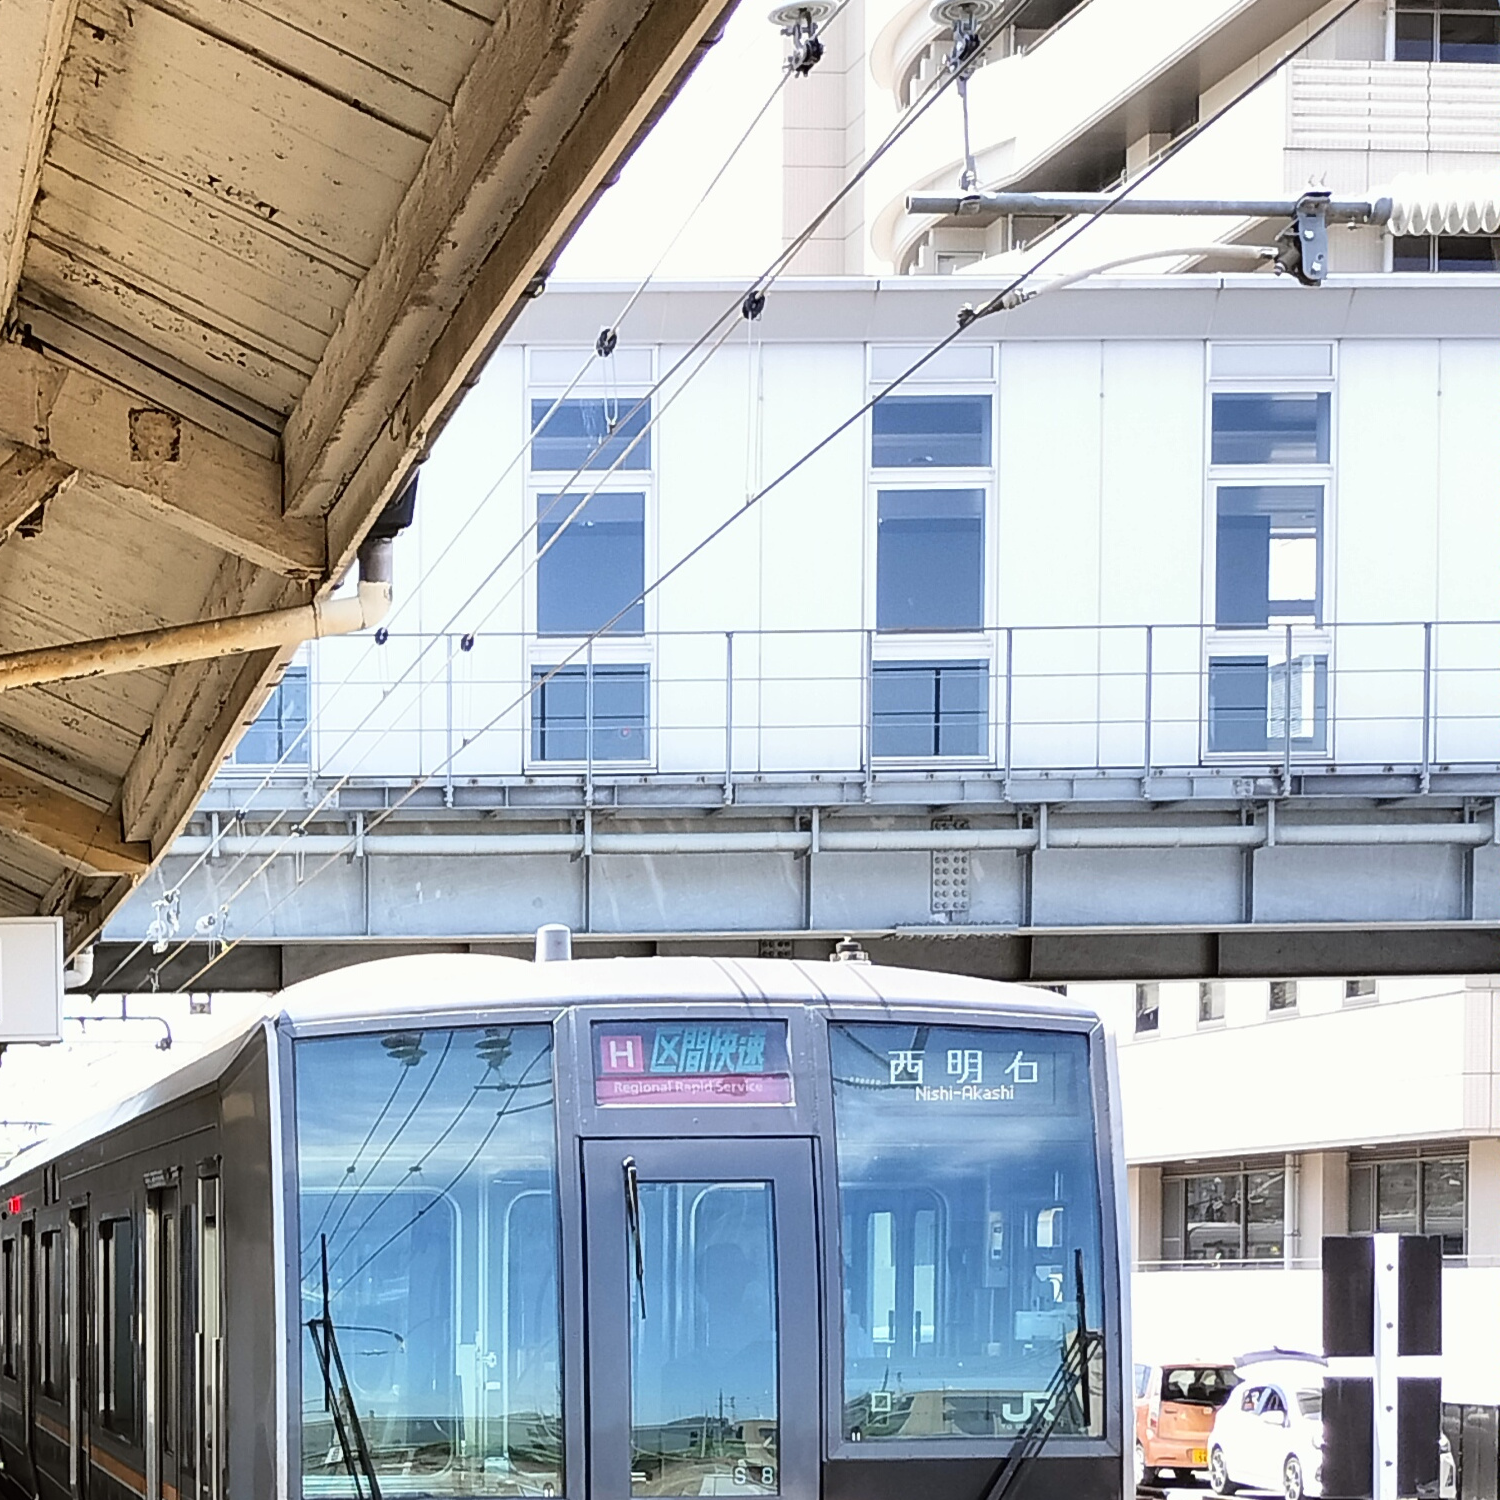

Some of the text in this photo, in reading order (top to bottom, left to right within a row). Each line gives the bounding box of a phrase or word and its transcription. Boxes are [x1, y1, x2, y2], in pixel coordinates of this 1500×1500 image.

[610, 1040, 635, 1068] H
[650, 1027, 766, 1073] 区間快速
[888, 1050, 1038, 1085] 西明石
[614, 1079, 763, 1095] Regional Rapid Service
[915, 1085, 1014, 1102] Nishi-Akashi
[1002, 1391, 1057, 1422] JR
[734, 1467, 774, 1485] S 8
